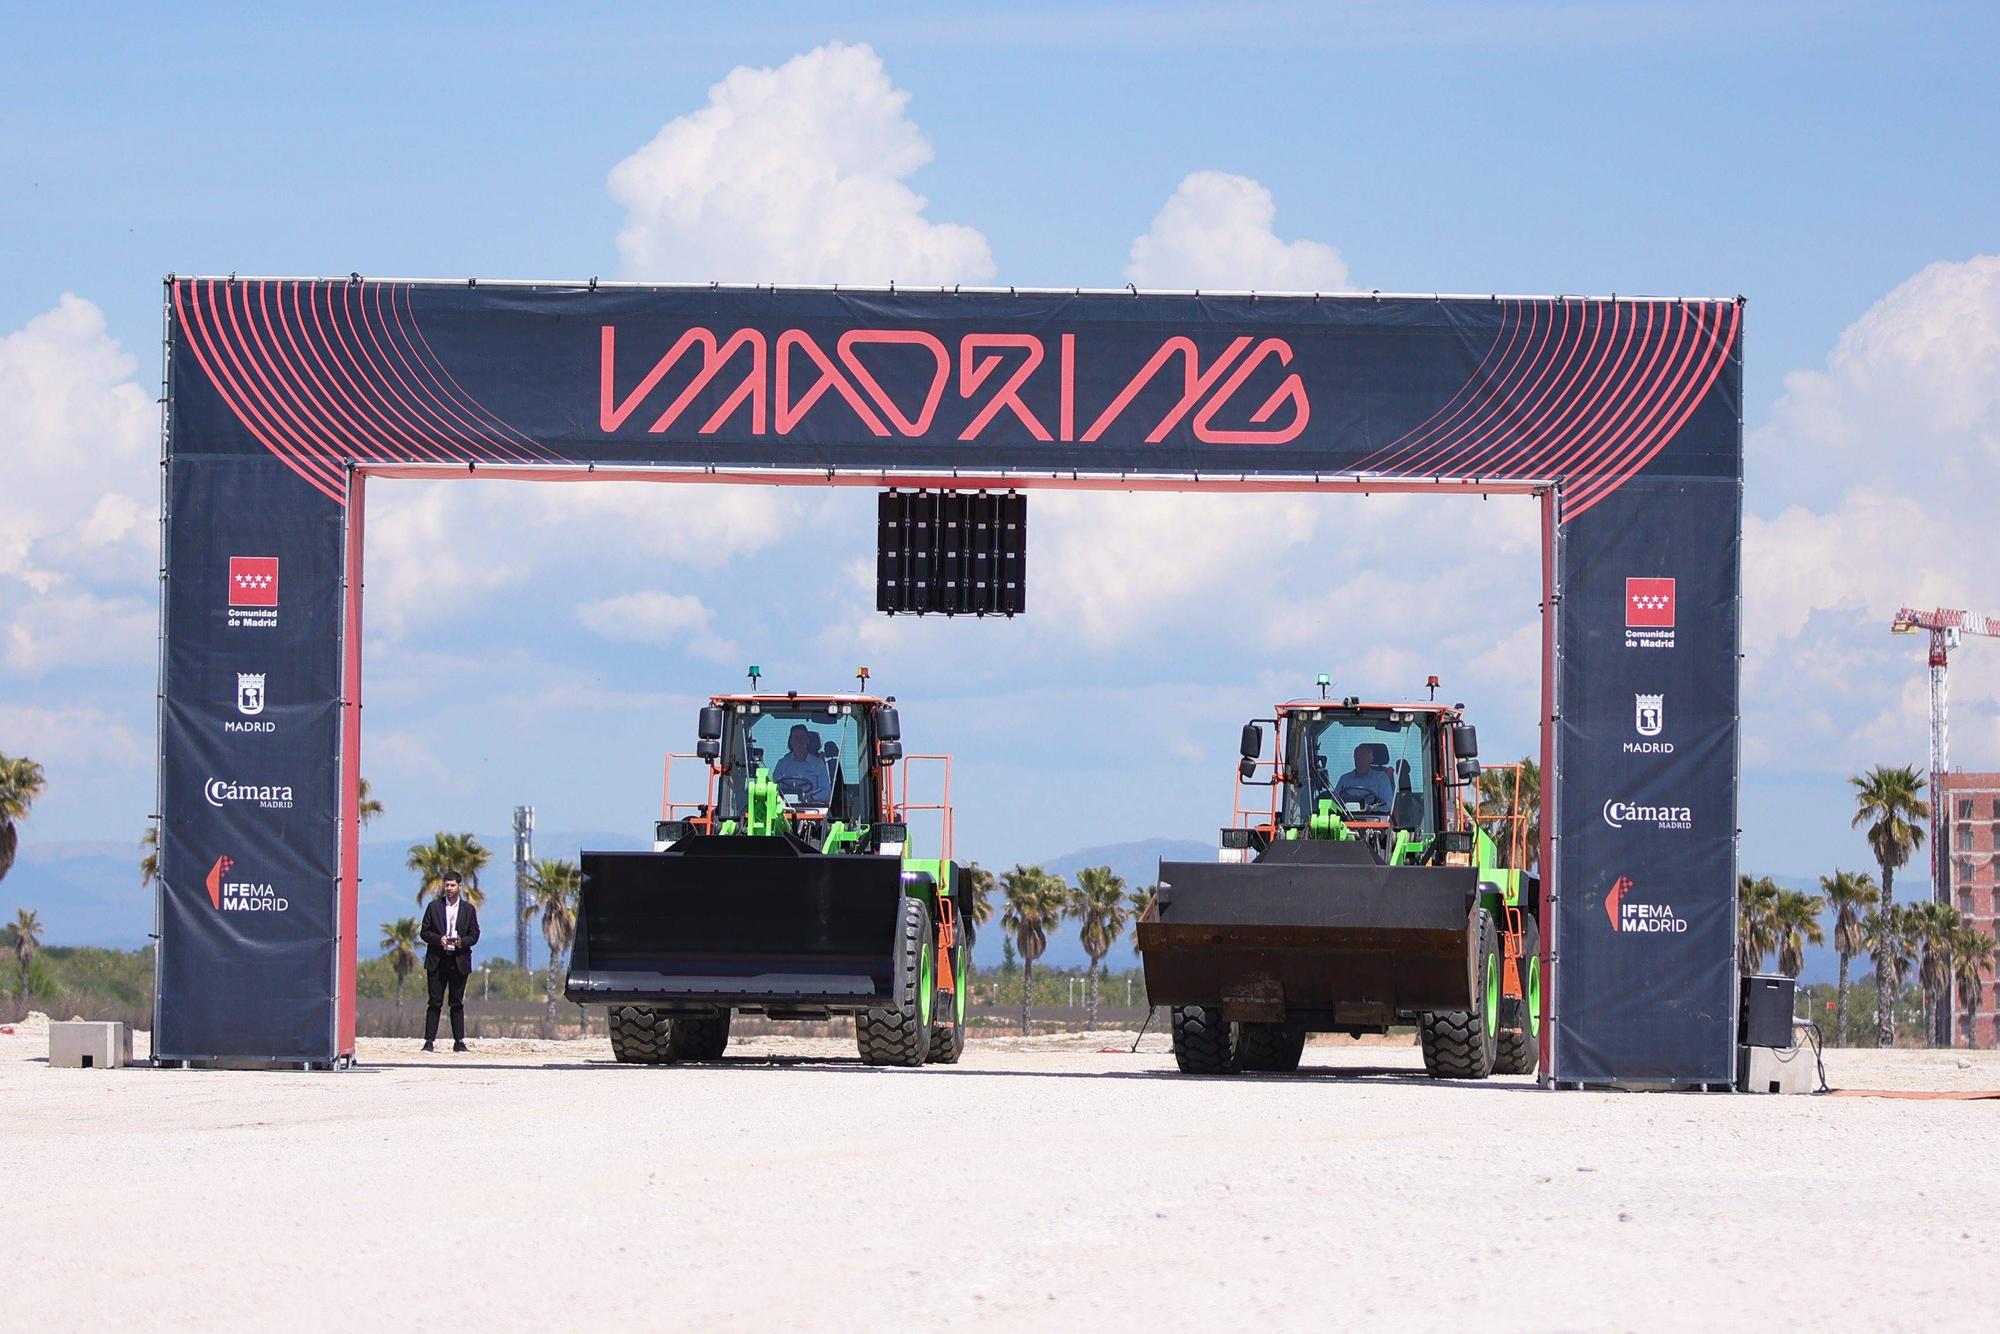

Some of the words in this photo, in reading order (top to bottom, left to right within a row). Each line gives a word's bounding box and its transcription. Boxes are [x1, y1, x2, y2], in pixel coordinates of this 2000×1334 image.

[600, 325, 1311, 444] MADRING
[228, 608, 278, 618] Comunidad
[228, 618, 241, 627] de
[243, 618, 278, 627] Madrid
[1625, 629, 1675, 639] Comunidad
[1625, 639, 1638, 648] de
[1640, 639, 1675, 648] Madrid
[224, 721, 276, 732] MADRID
[1623, 742, 1674, 753] MADRID
[210, 780, 293, 801] Cámara
[259, 801, 293, 809] MADRID
[1608, 801, 1692, 822] Cámara
[1658, 821, 1692, 829] MADRID
[223, 883, 275, 897] IFEMA
[223, 897, 289, 912] MADRID
[1622, 904, 1674, 918] IFEMA
[1622, 918, 1688, 933] MADRID
